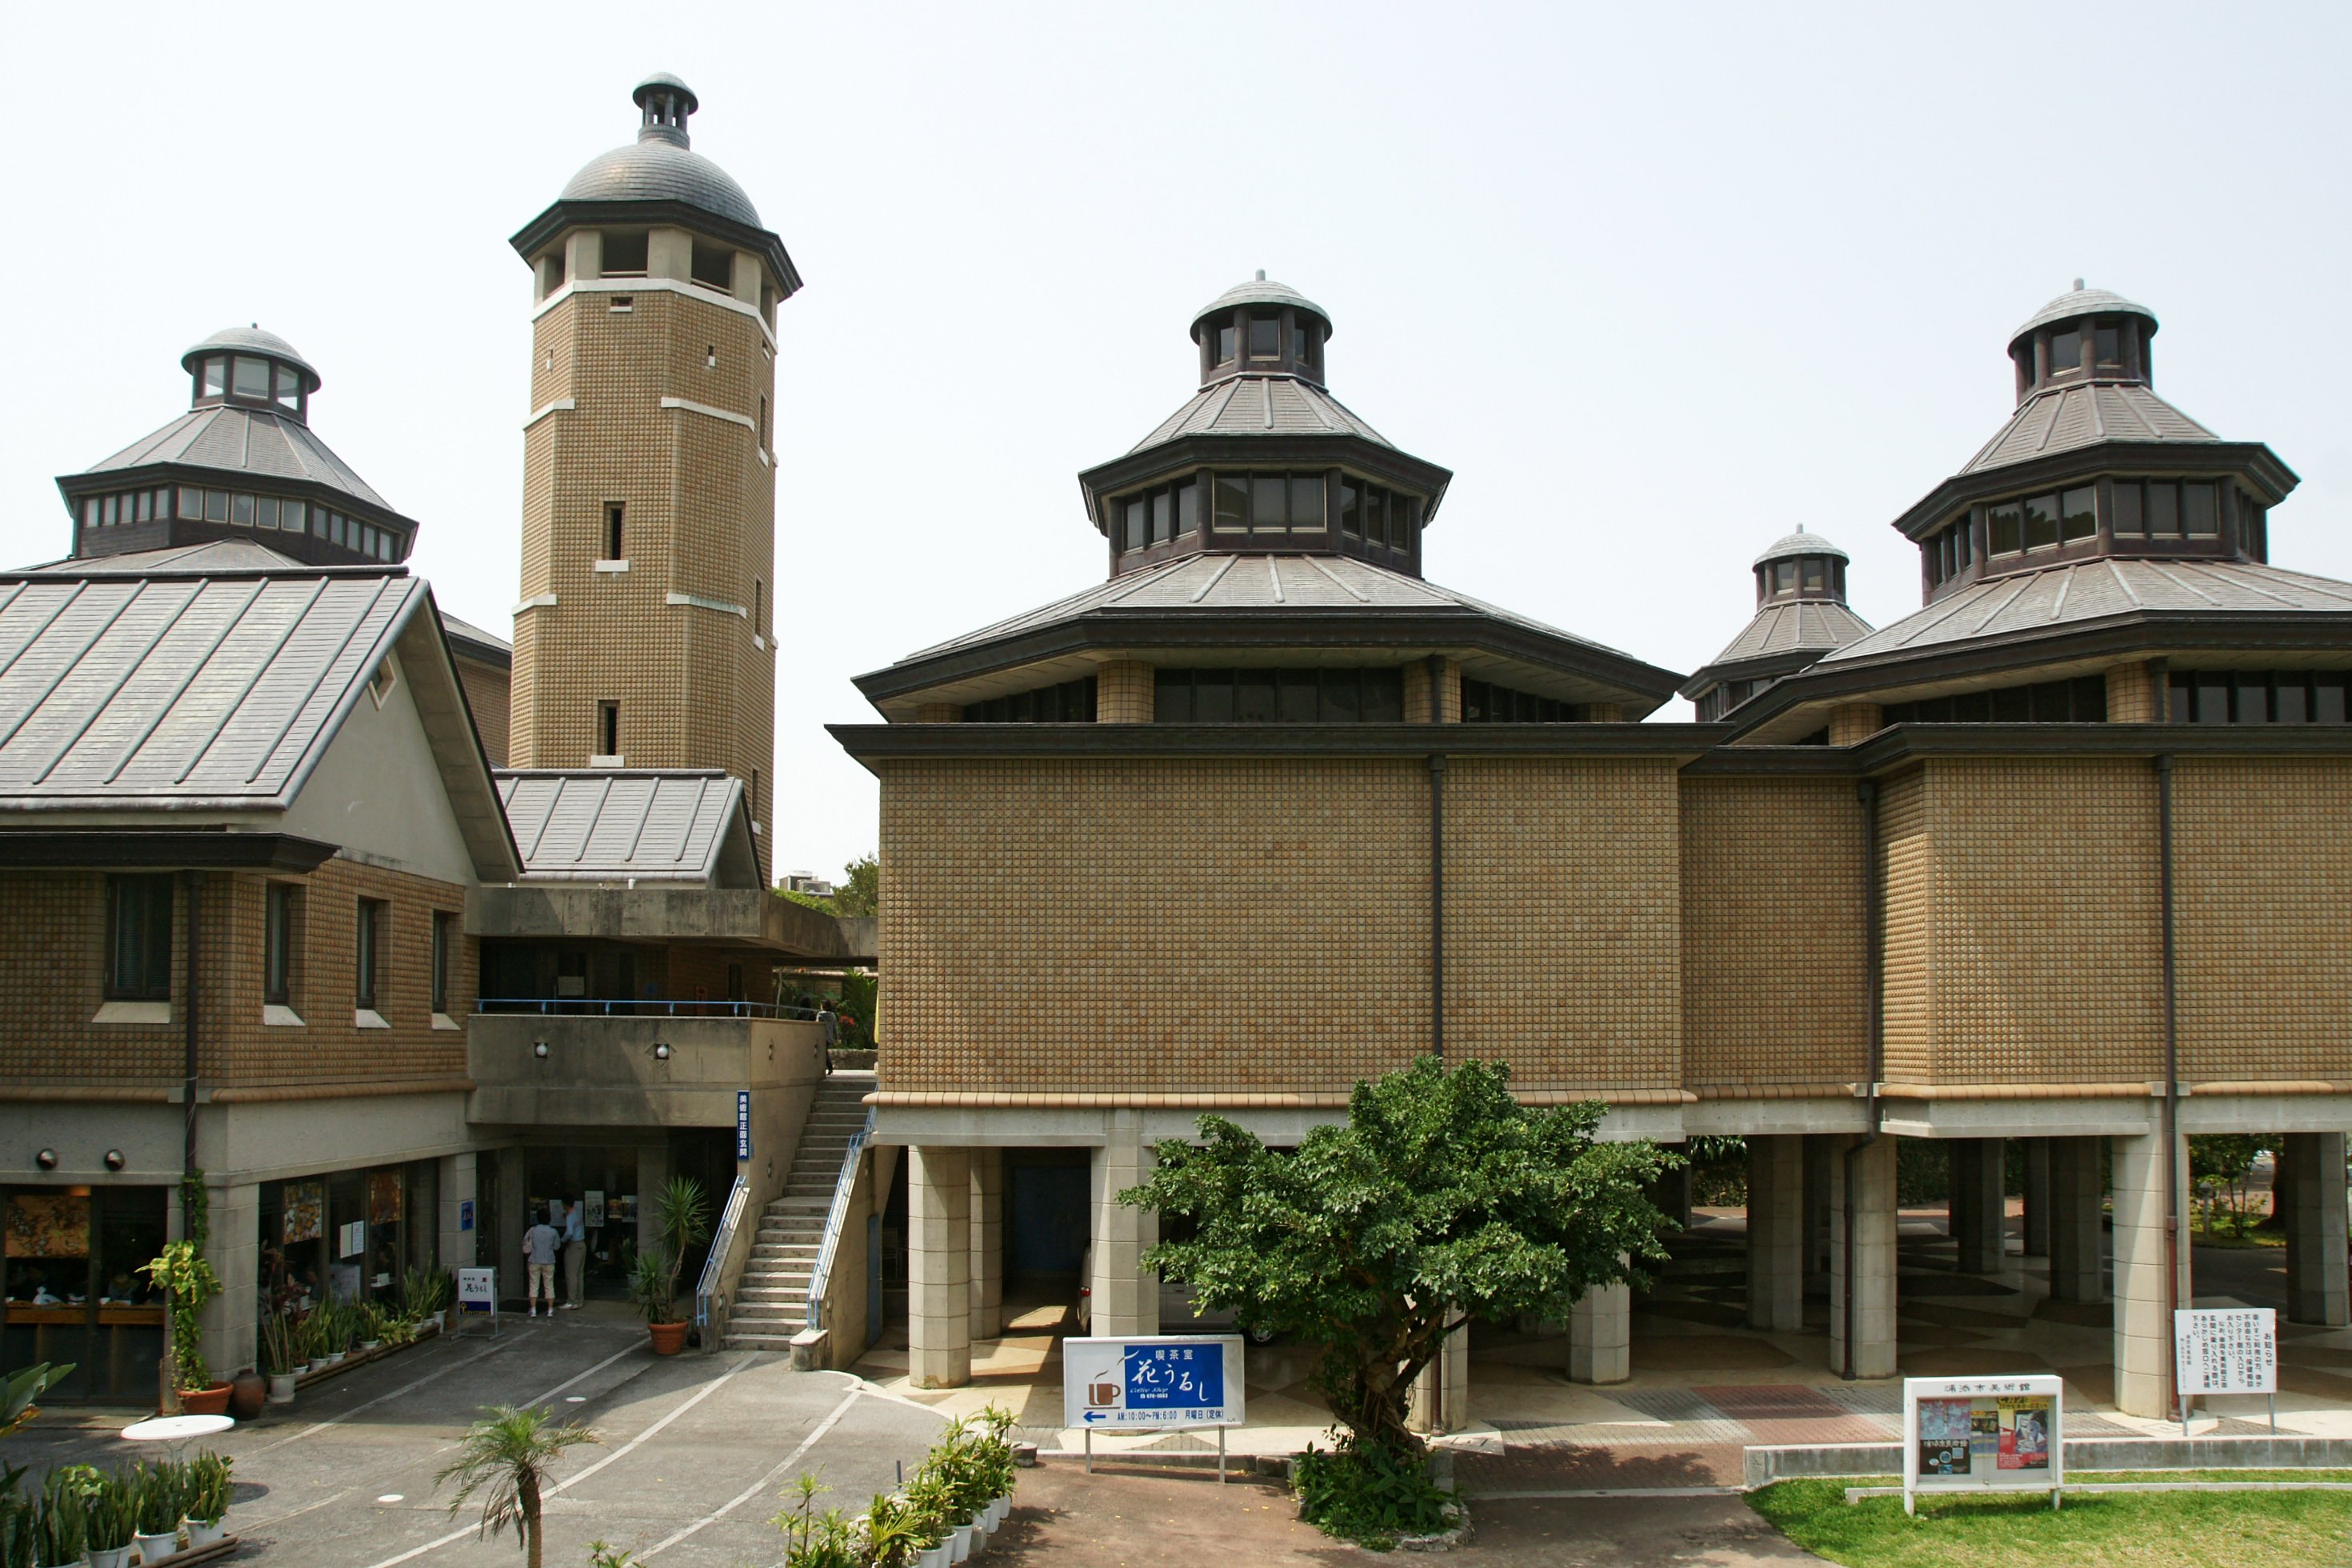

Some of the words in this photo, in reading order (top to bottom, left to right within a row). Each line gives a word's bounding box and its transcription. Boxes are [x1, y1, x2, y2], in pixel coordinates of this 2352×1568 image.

[739, 1094, 747, 1157] 美術館正面玄関
[1155, 1349, 1194, 1361] 喫茶室
[2264, 1333, 2272, 1366] お知らせ
[1131, 1359, 1209, 1402] 花うるし
[1944, 1382, 2030, 1393] 浦添市美術館
